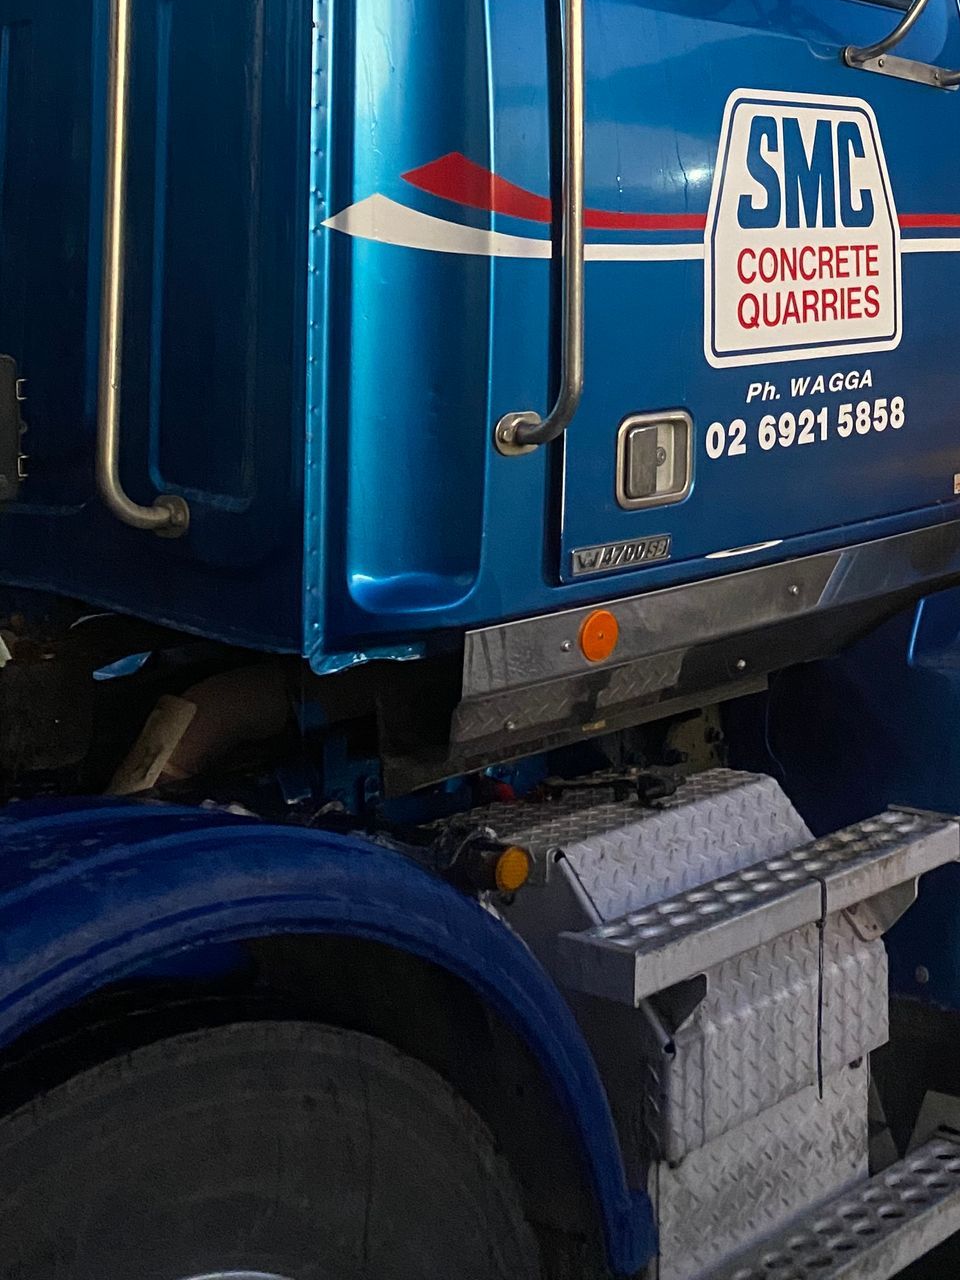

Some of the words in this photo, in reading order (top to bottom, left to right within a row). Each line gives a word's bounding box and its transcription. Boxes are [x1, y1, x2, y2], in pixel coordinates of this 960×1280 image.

[737, 115, 874, 228] SMC
[737, 244, 880, 284] CONCRETE
[737, 284, 880, 330] QUARRIES
[746, 380, 781, 403] Ph.
[790, 368, 873, 398] WAGGA
[705, 418, 748, 460] 02
[757, 403, 829, 452] 6921
[837, 396, 905, 439] 5858
